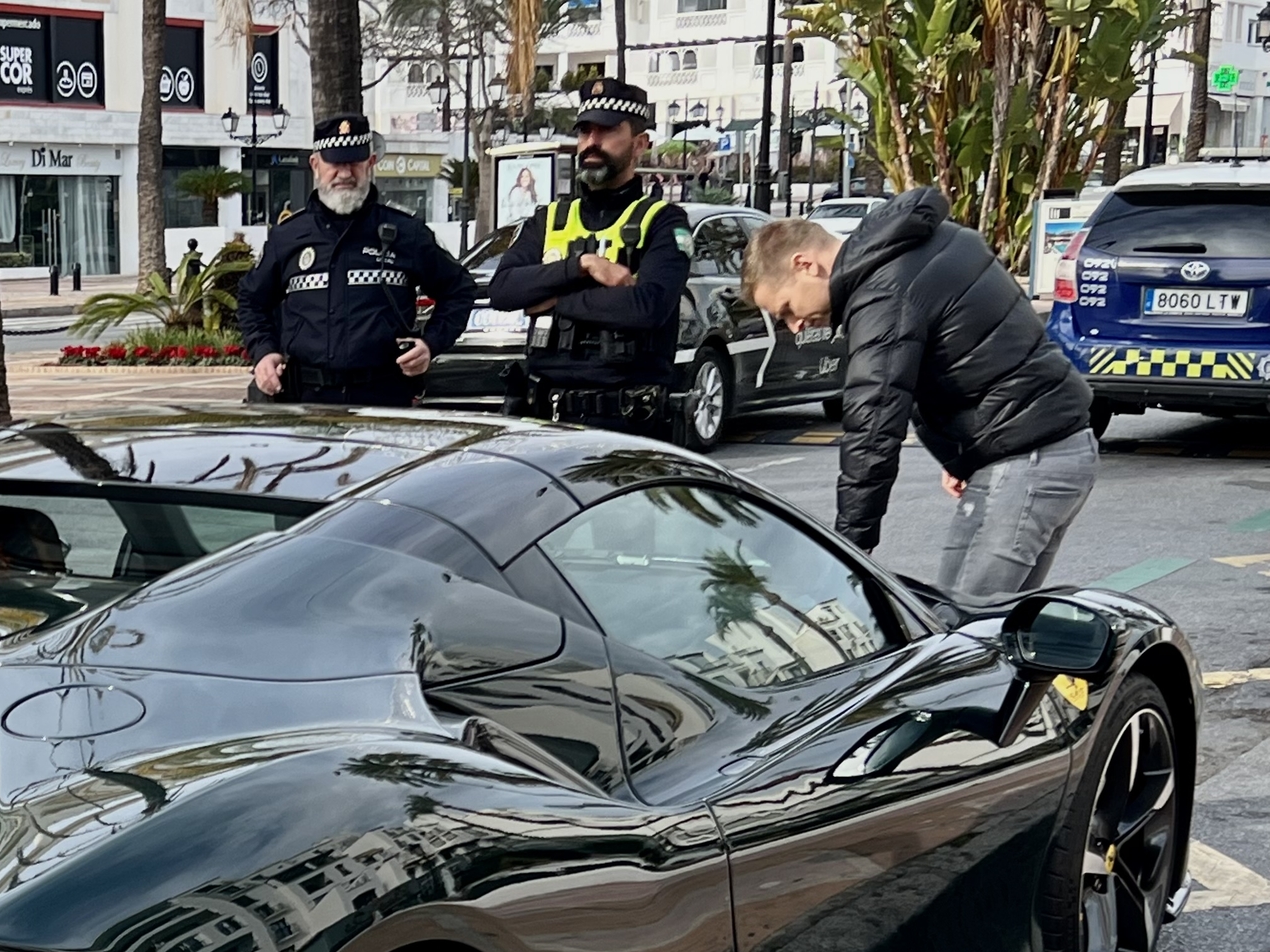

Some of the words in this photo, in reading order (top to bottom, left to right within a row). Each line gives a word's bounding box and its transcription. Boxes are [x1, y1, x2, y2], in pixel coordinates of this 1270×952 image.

[0, 45, 33, 63] SUPER
[0, 62, 33, 85] COR
[31, 147, 46, 168] Di
[49, 149, 73, 168] Mar
[1079, 283, 1107, 295] 092
[1078, 296, 1106, 307] 092
[1157, 293, 1201, 309] 8060
[1206, 294, 1241, 310] LTW
